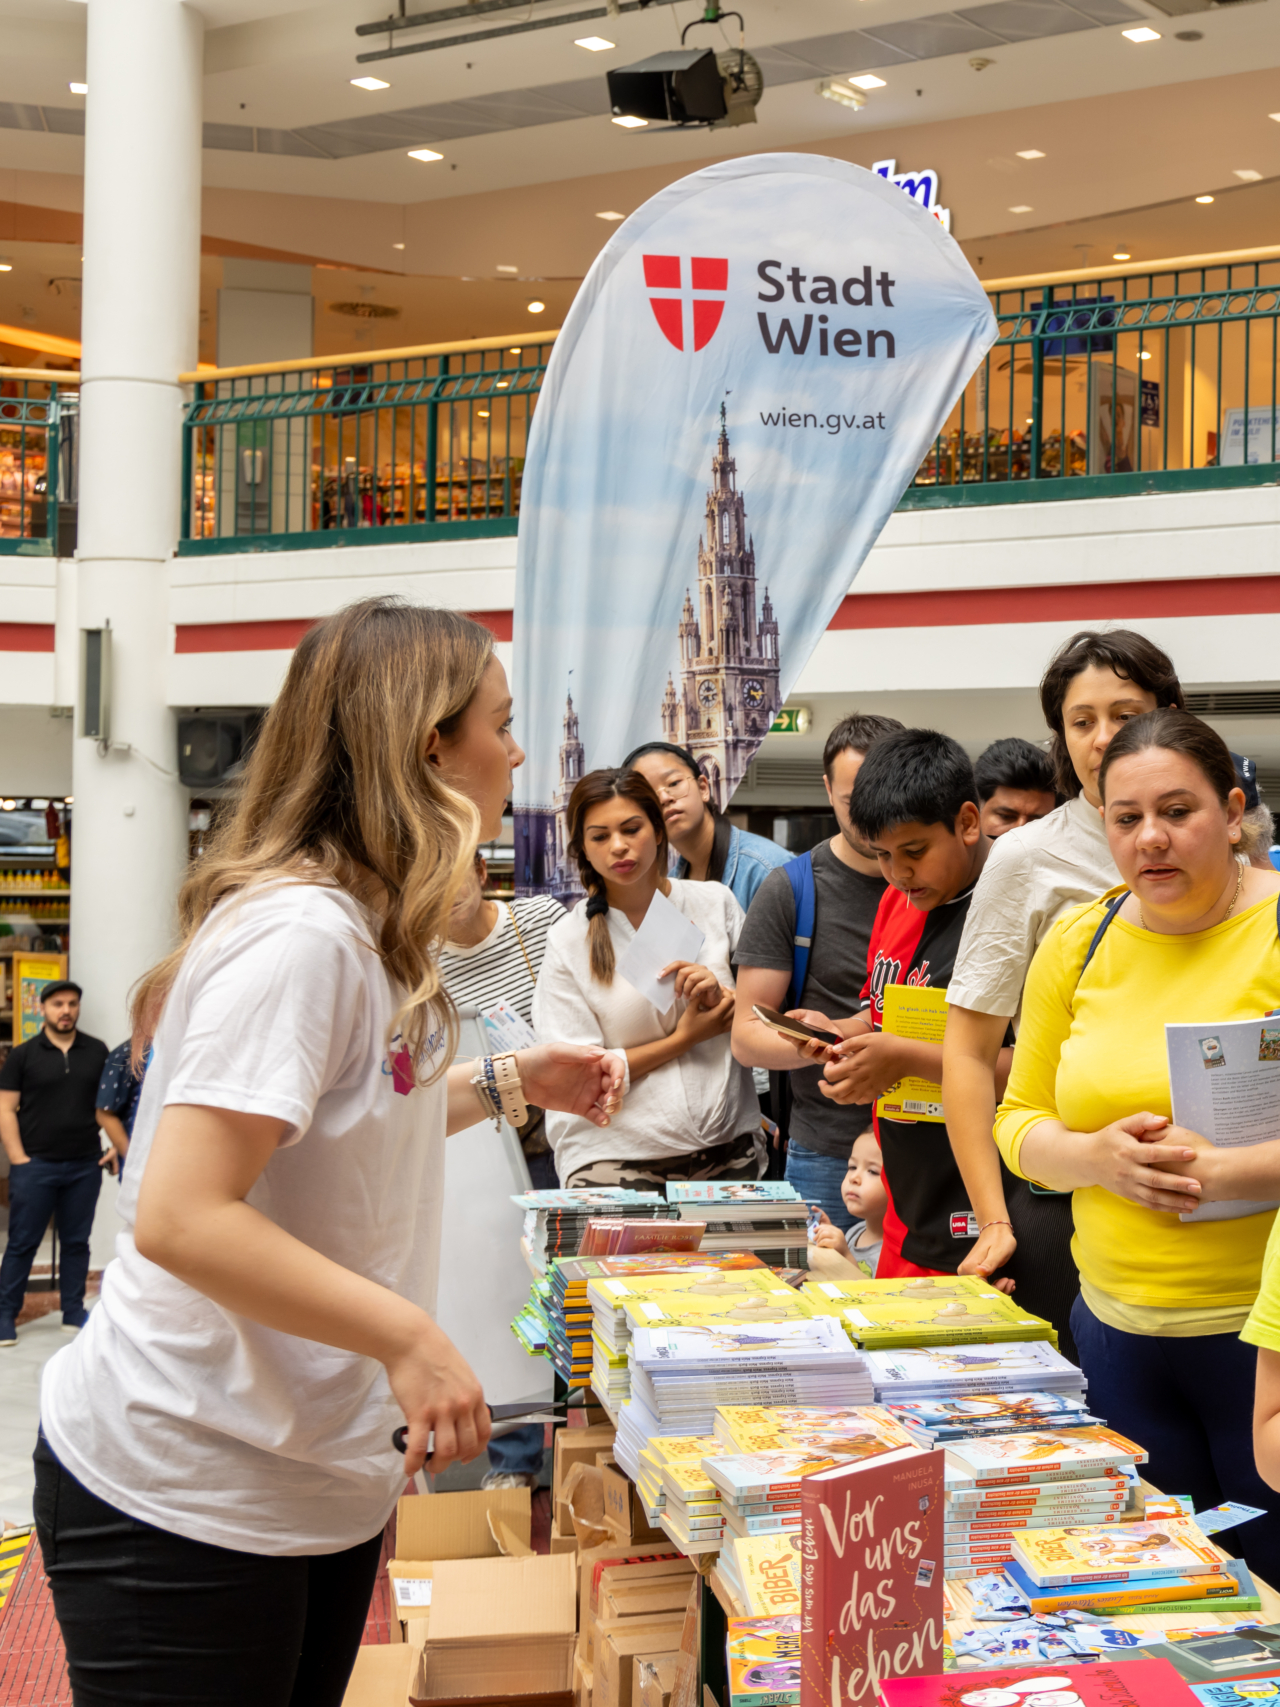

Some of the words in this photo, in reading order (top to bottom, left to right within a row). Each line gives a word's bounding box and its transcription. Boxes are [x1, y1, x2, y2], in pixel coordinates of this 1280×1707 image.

[756, 259, 896, 308] Stadt
[757, 312, 896, 359] Wien
[760, 407, 886, 435] wien.gv.at
[893, 1465, 934, 1483] MANUELA
[908, 1477, 934, 1491] INUSA
[802, 1518, 819, 1560] Leben
[818, 1489, 884, 1558] Vor
[865, 1520, 922, 1571] uns
[1034, 1536, 1075, 1562] BIBER
[759, 1554, 800, 1605] BIBER
[803, 1564, 815, 1585] das
[804, 1588, 815, 1610] uns
[839, 1570, 896, 1635] das
[802, 1612, 814, 1633] Vor
